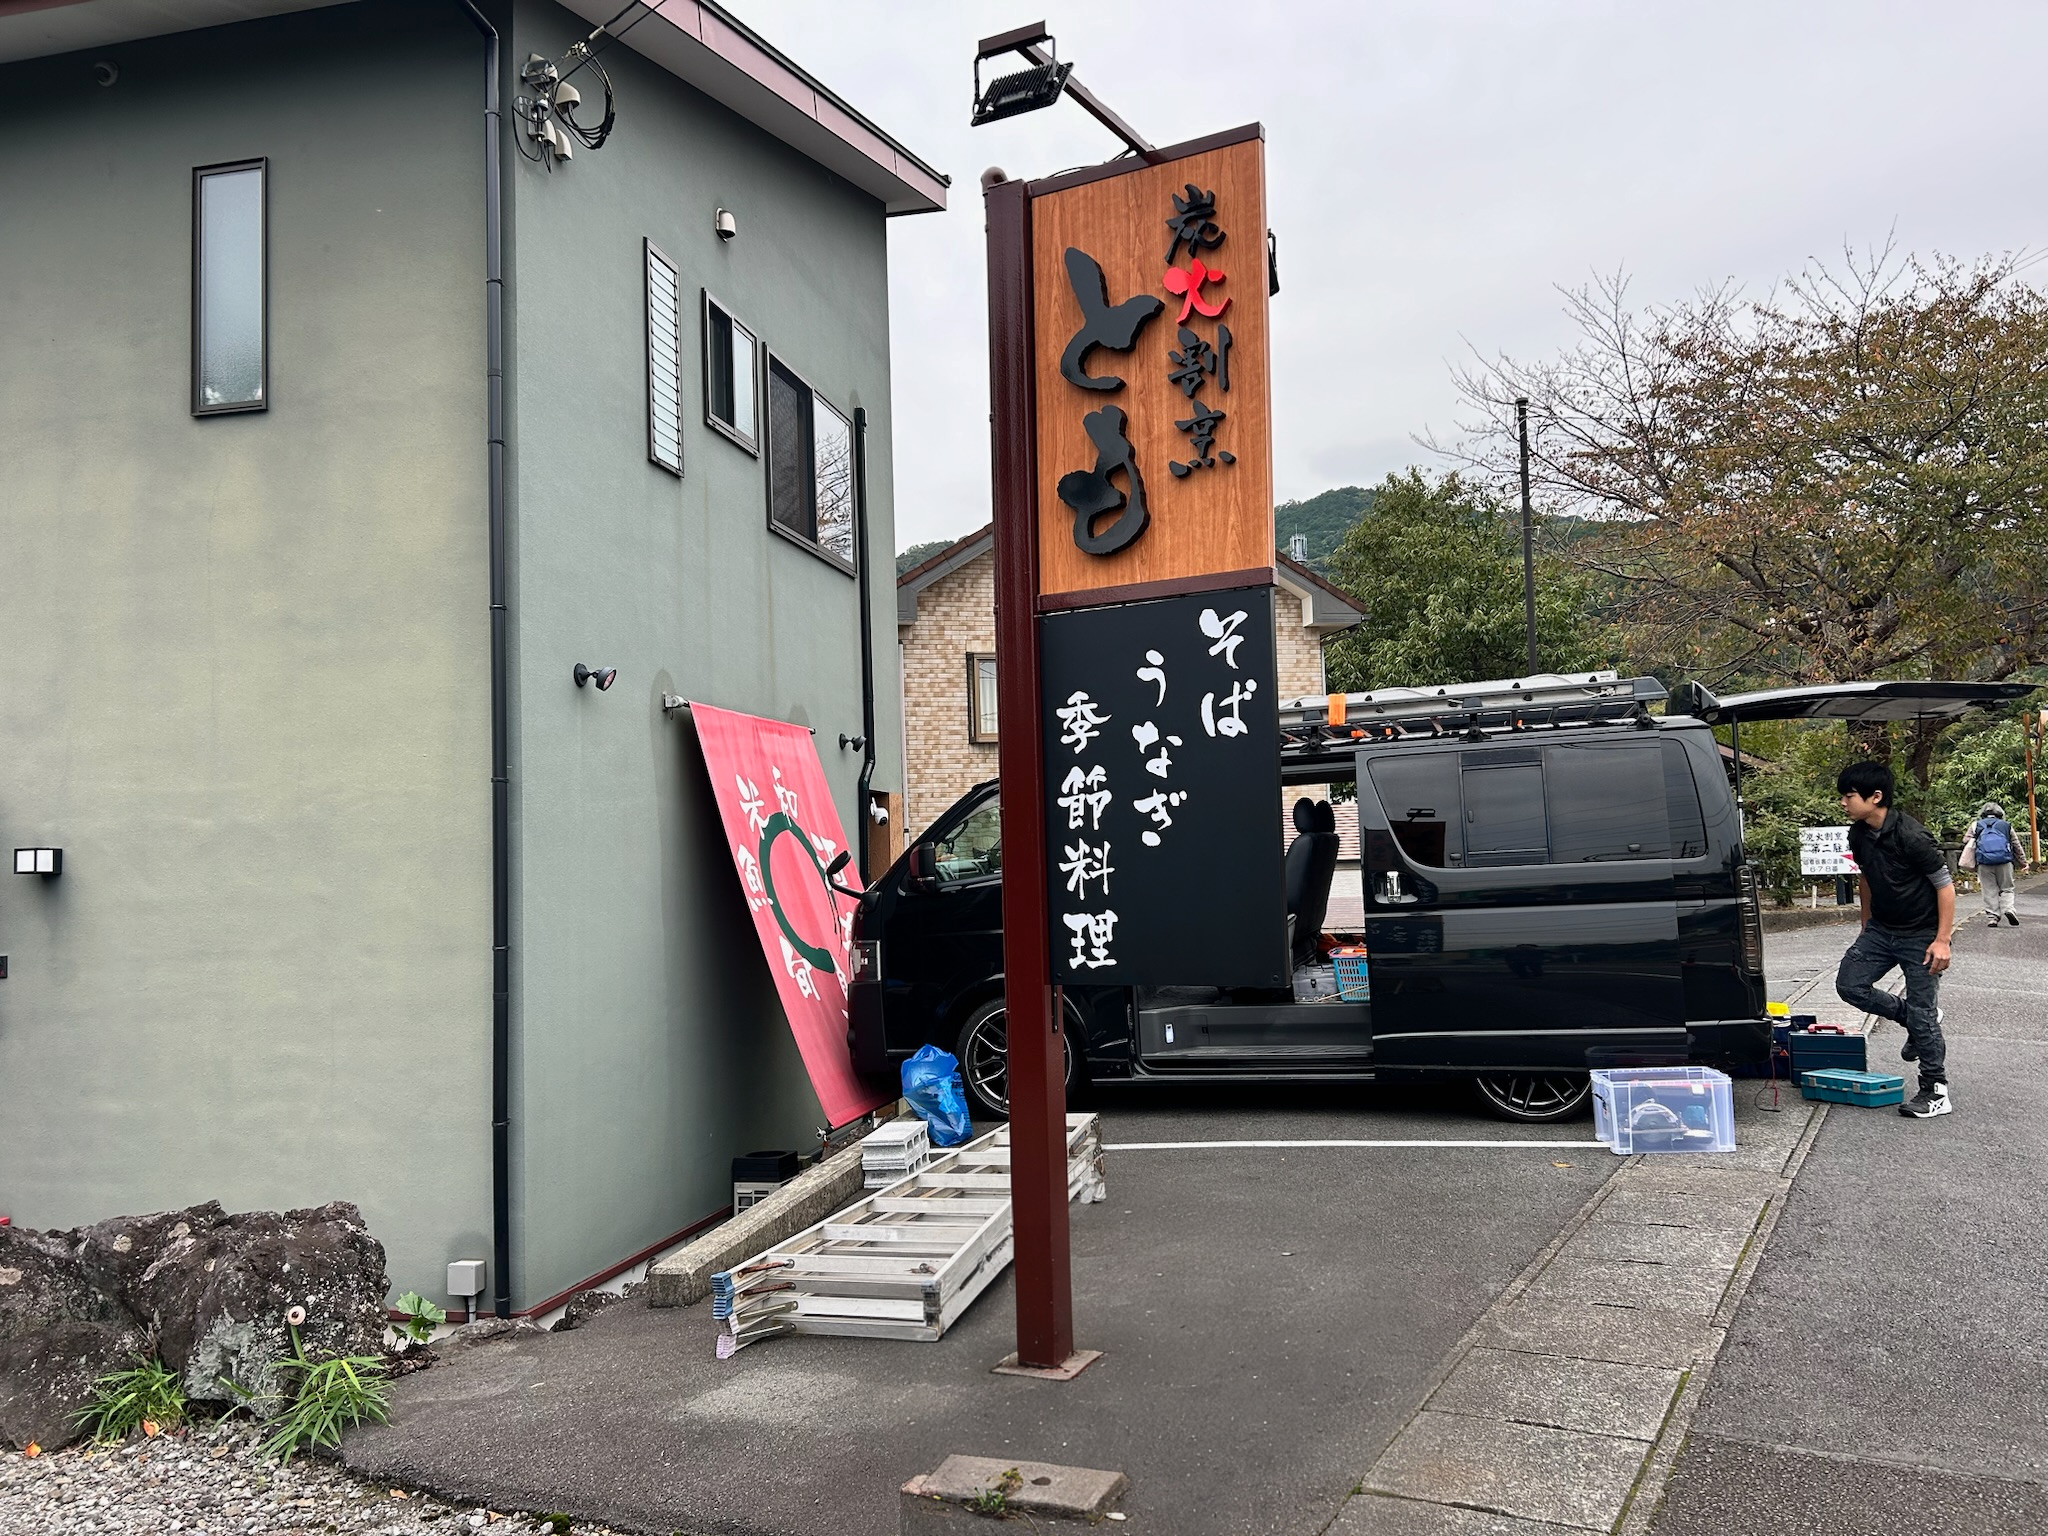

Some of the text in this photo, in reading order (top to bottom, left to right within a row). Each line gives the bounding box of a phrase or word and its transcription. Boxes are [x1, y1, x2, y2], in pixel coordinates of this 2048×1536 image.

[1057, 246, 1165, 556] とも
[1163, 183, 1236, 478] 炭火割烹
[1131, 649, 1187, 847] うなぎ
[1199, 608, 1257, 738] そば
[1056, 690, 1119, 969] 季節料理
